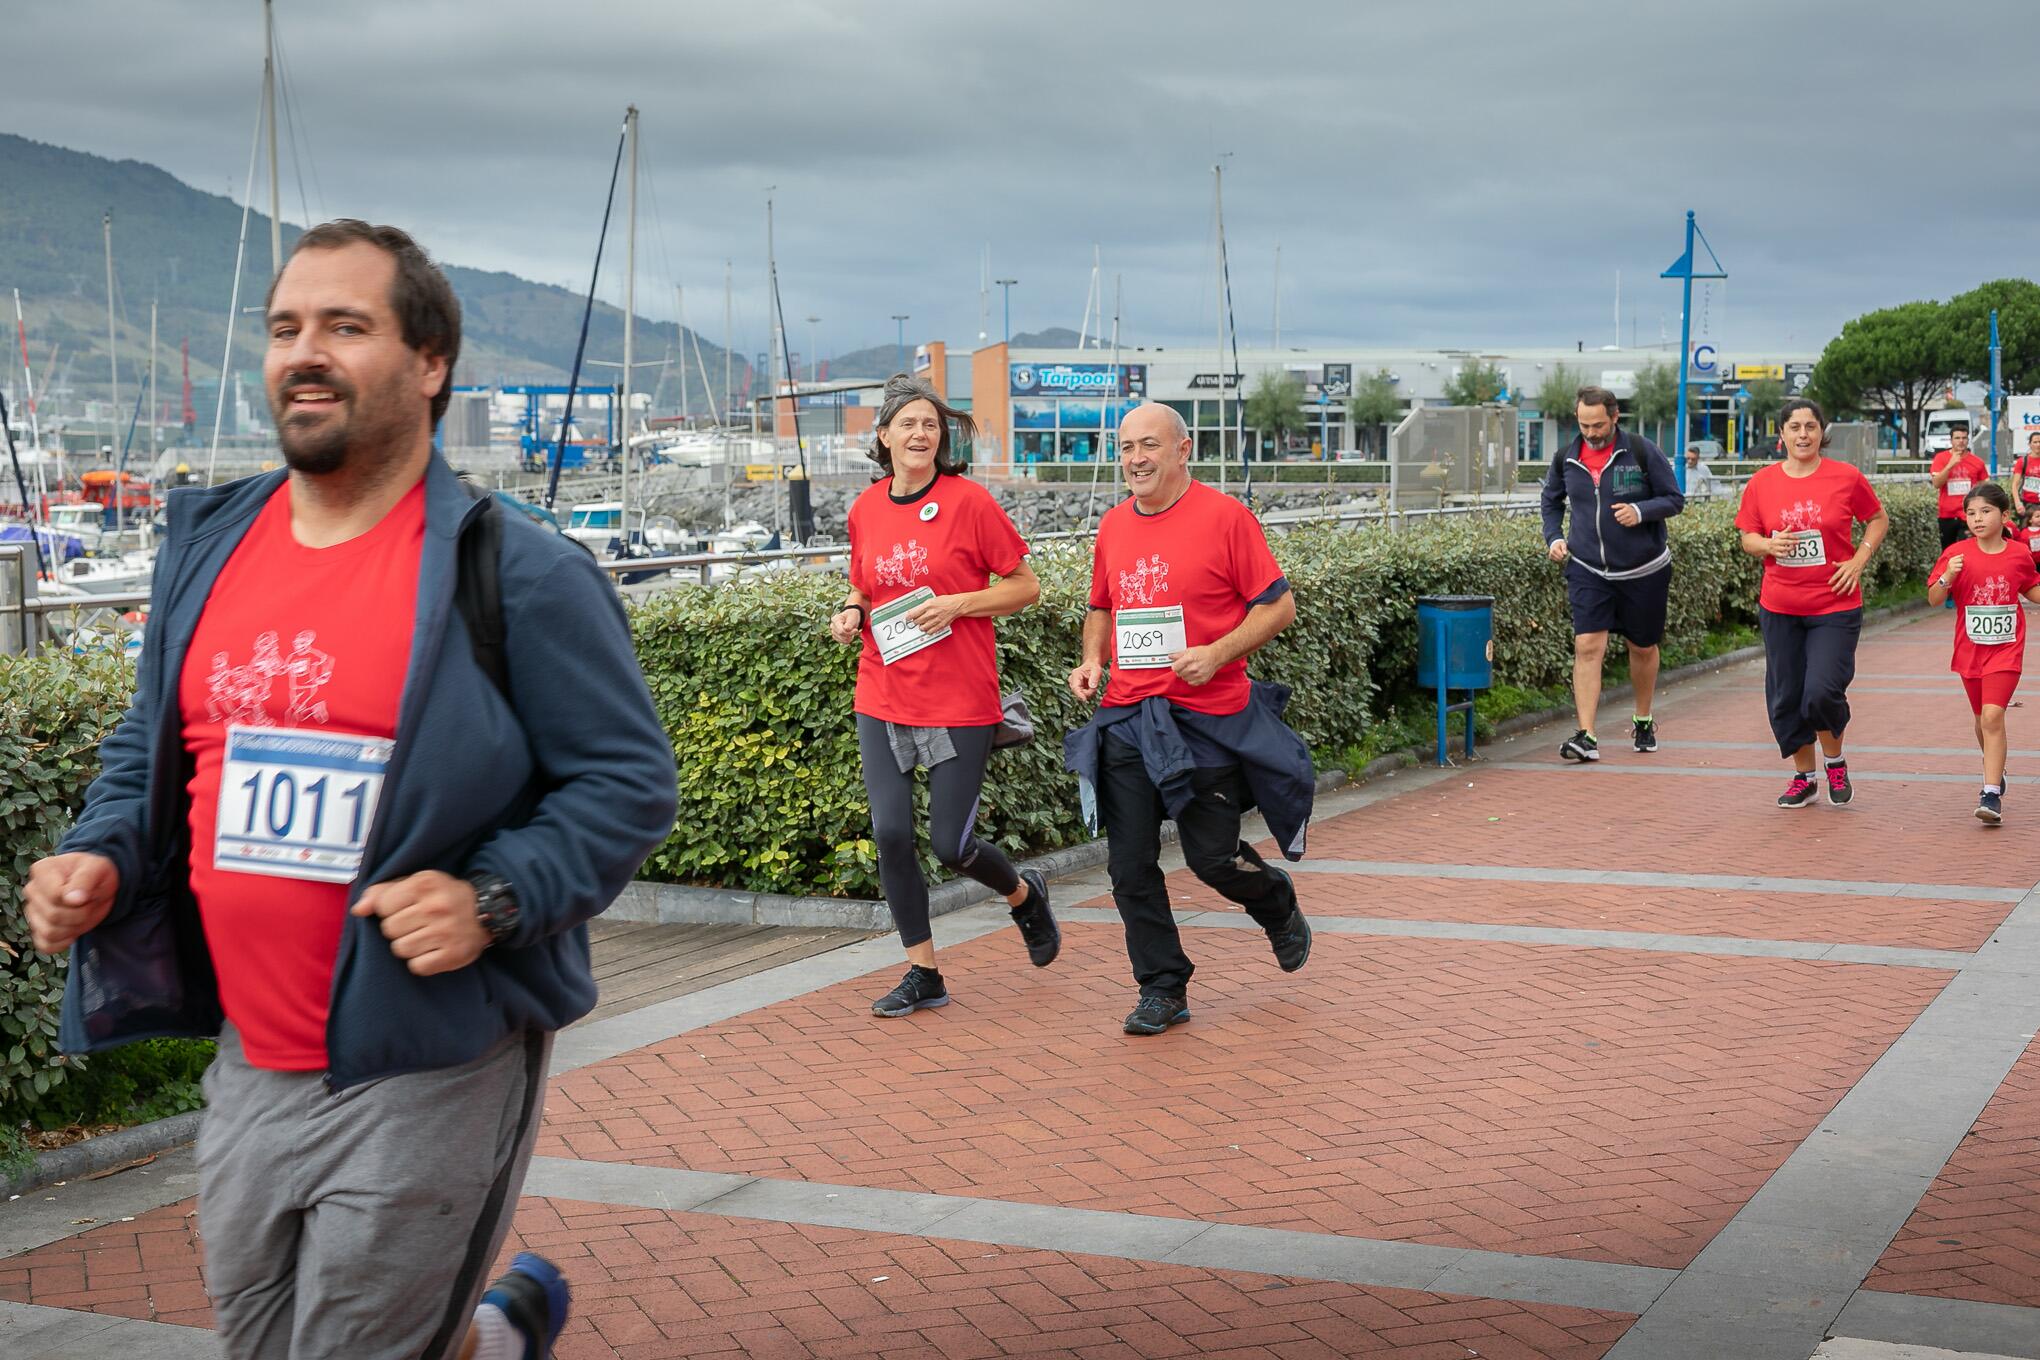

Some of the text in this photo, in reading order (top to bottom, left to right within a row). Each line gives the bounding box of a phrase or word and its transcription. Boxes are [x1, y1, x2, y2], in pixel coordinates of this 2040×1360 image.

[1694, 345, 1716, 371] C
[882, 619, 918, 641] 206
[1972, 615, 2012, 635] 2053
[1123, 630, 1164, 650] 2069
[241, 768, 372, 844] 1011
